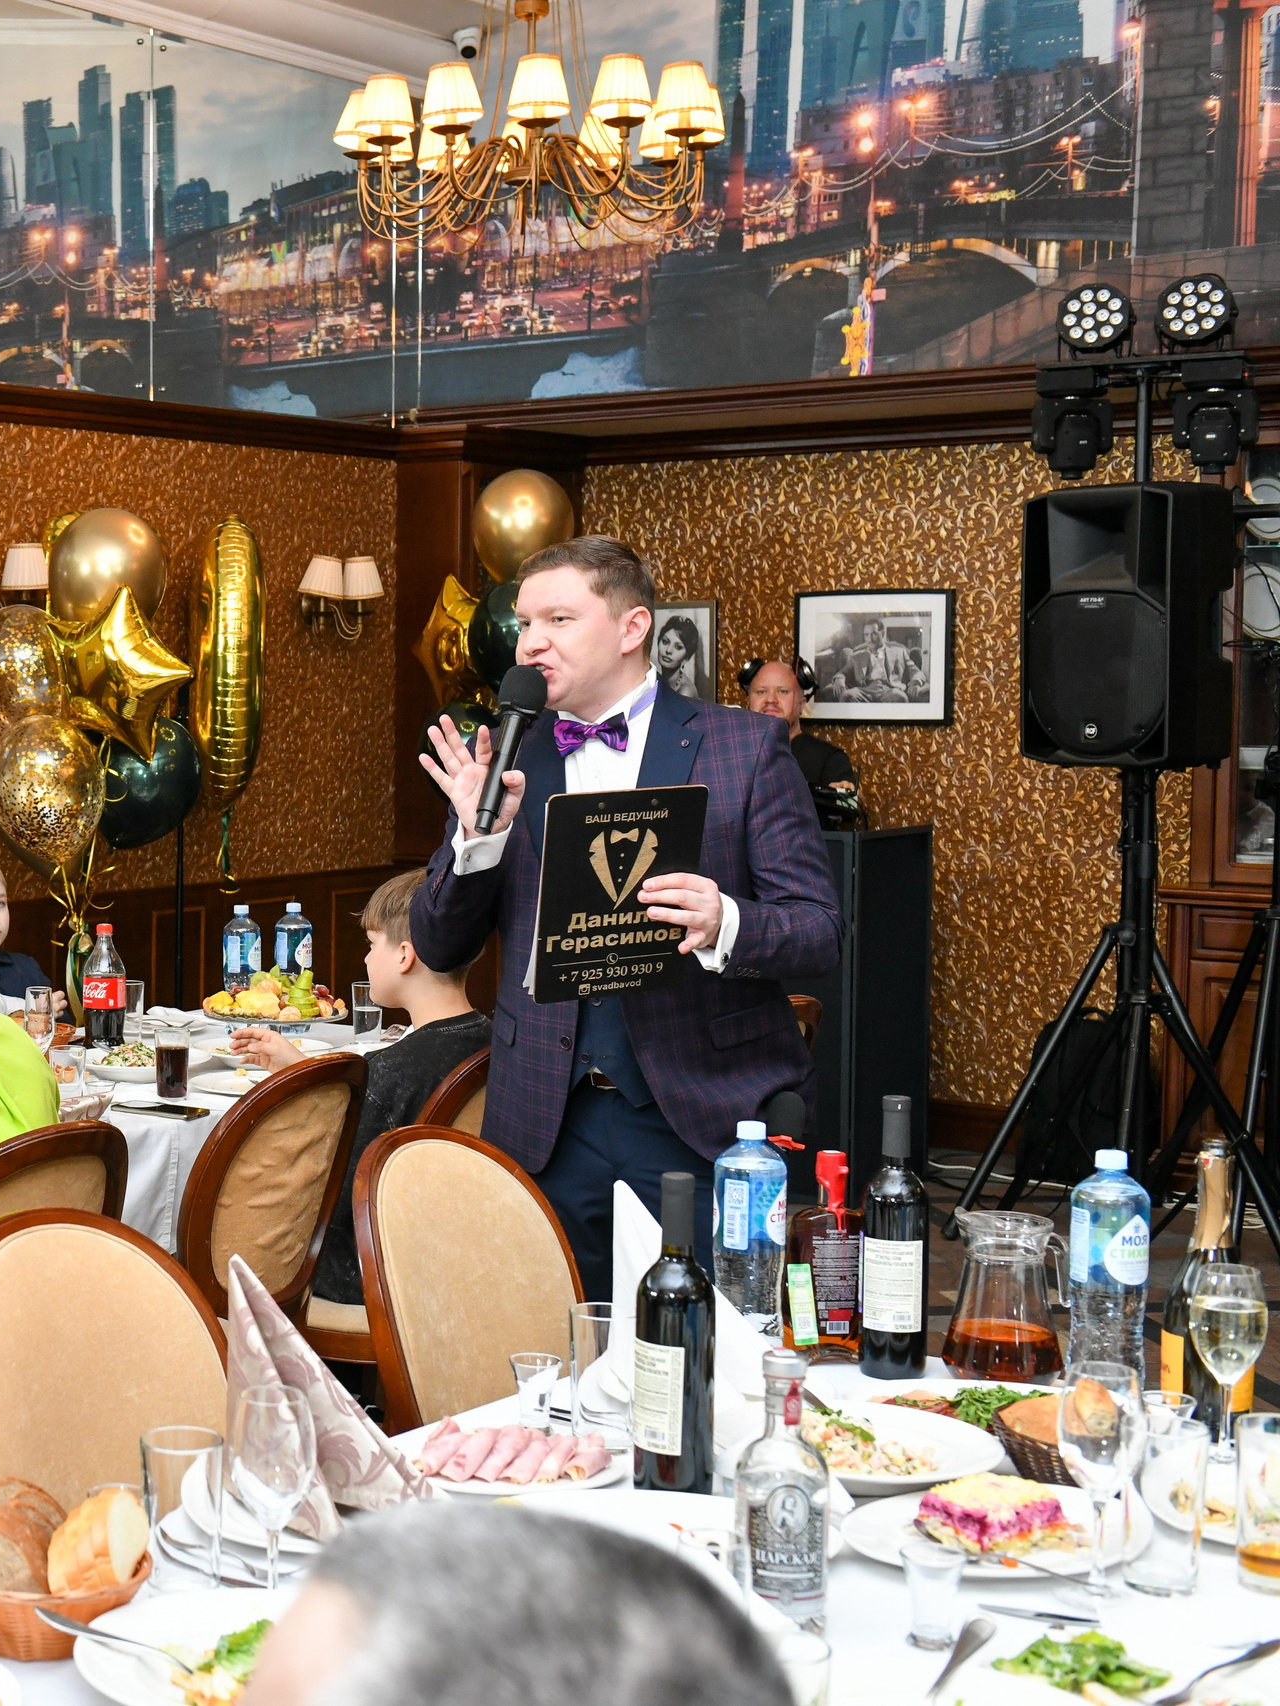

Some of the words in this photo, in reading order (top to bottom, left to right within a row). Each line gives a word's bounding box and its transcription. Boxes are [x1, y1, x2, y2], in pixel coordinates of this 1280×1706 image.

[585, 814, 611, 824] ВАШ
[613, 807, 669, 822] ВЕДУЩИЙ
[567, 910, 658, 933] Данил
[545, 927, 682, 953] Герасимов
[570, 970, 579, 982] 7
[581, 968, 603, 981] 925
[606, 965, 628, 978] 930
[631, 962, 653, 976] 930
[655, 961, 664, 972] 9
[83, 981, 109, 998] Cola
[591, 978, 642, 991] svadbavod
[1121, 1234, 1148, 1246] МОЯ
